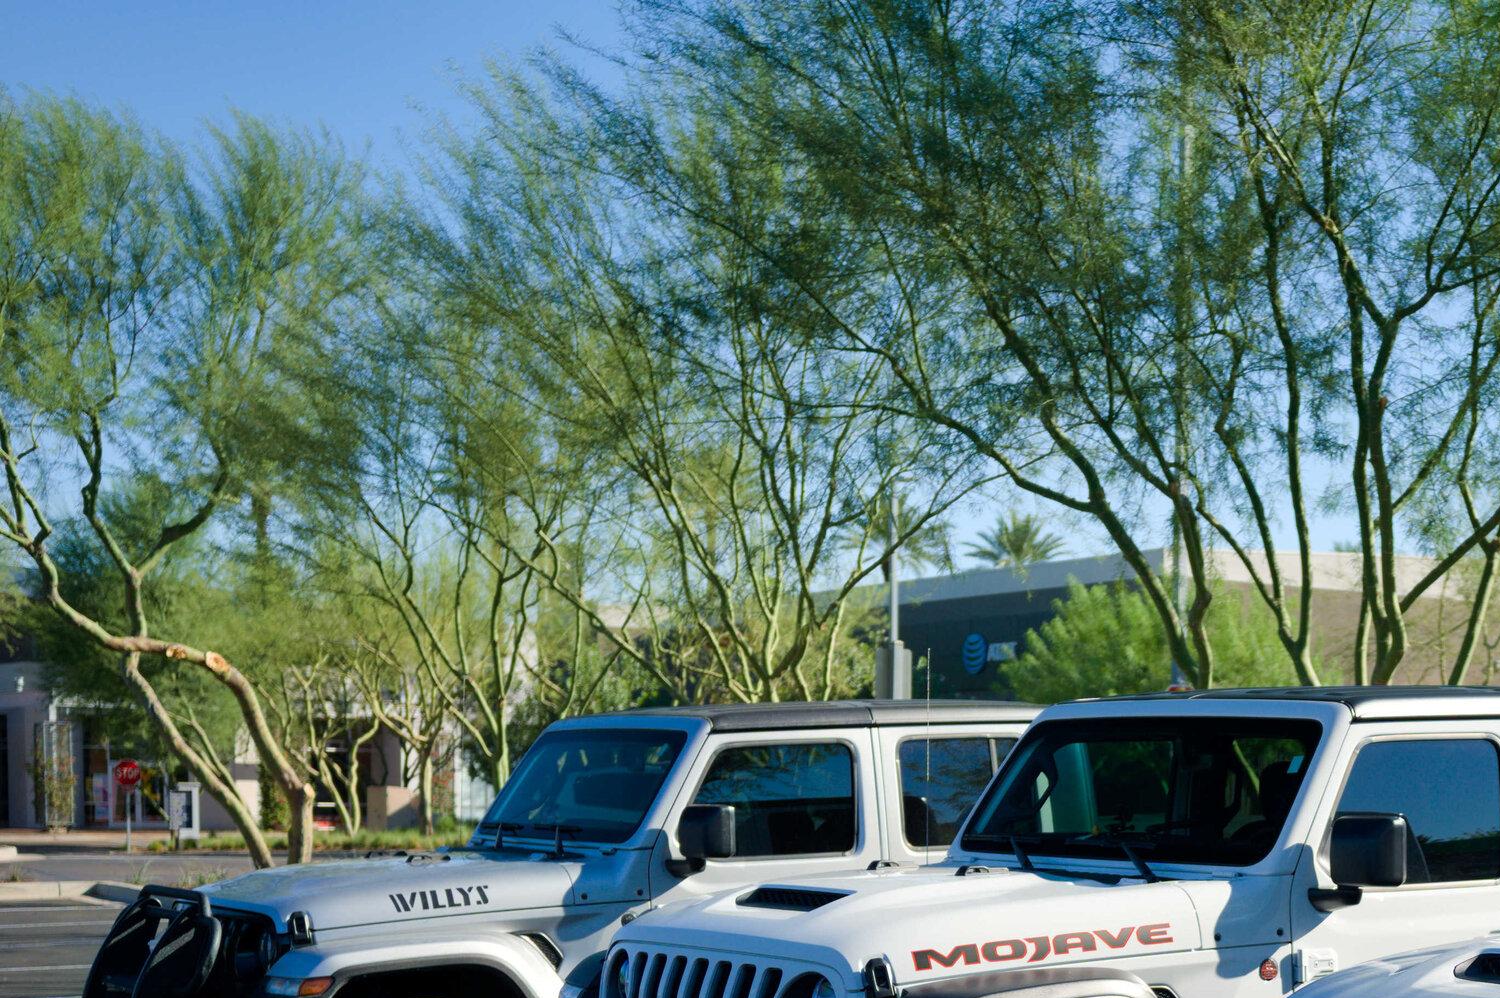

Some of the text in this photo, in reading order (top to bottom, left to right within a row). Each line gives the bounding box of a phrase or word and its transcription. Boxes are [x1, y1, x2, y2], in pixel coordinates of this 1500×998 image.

[116, 768, 140, 779] STOP
[388, 884, 490, 913] WILLYS
[910, 922, 1174, 972] MOJAVE
